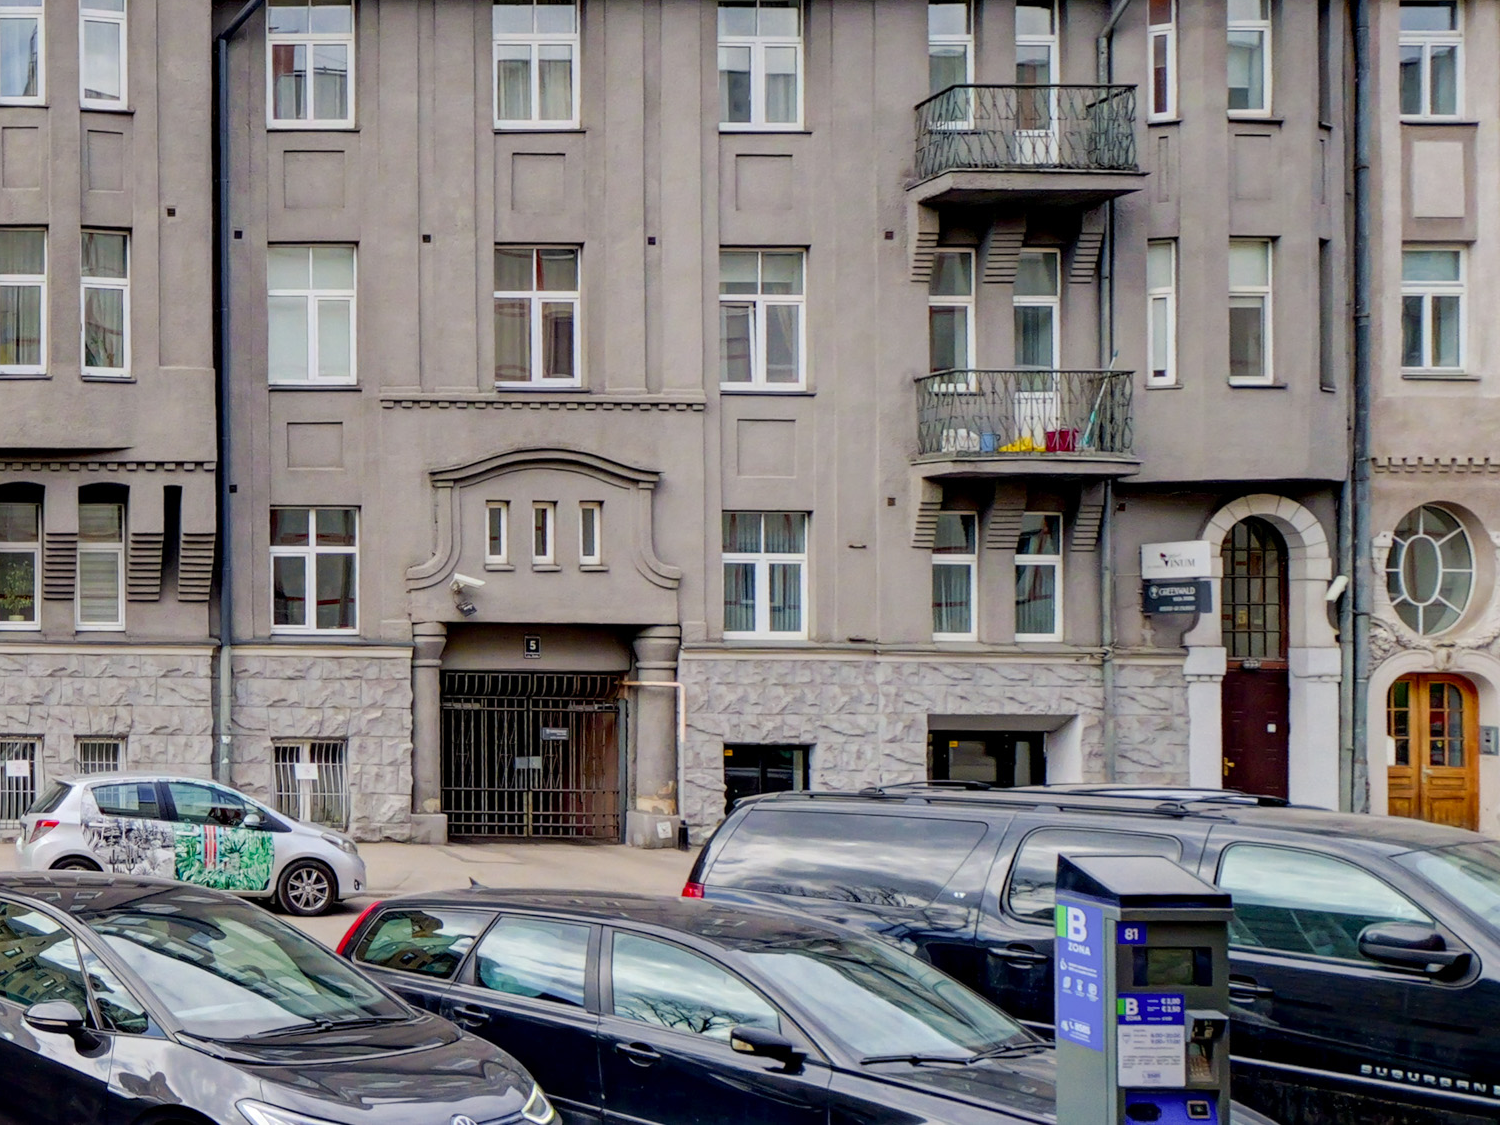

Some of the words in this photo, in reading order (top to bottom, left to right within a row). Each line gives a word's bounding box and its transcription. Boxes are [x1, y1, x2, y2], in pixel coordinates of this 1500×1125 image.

[529, 640, 537, 650] 5
[1067, 906, 1087, 942] B
[1124, 928, 1139, 940] 81
[1068, 942, 1091, 956] ZONA
[1125, 998, 1139, 1015] B
[1361, 1064, 1487, 1092] SUBURBAN
